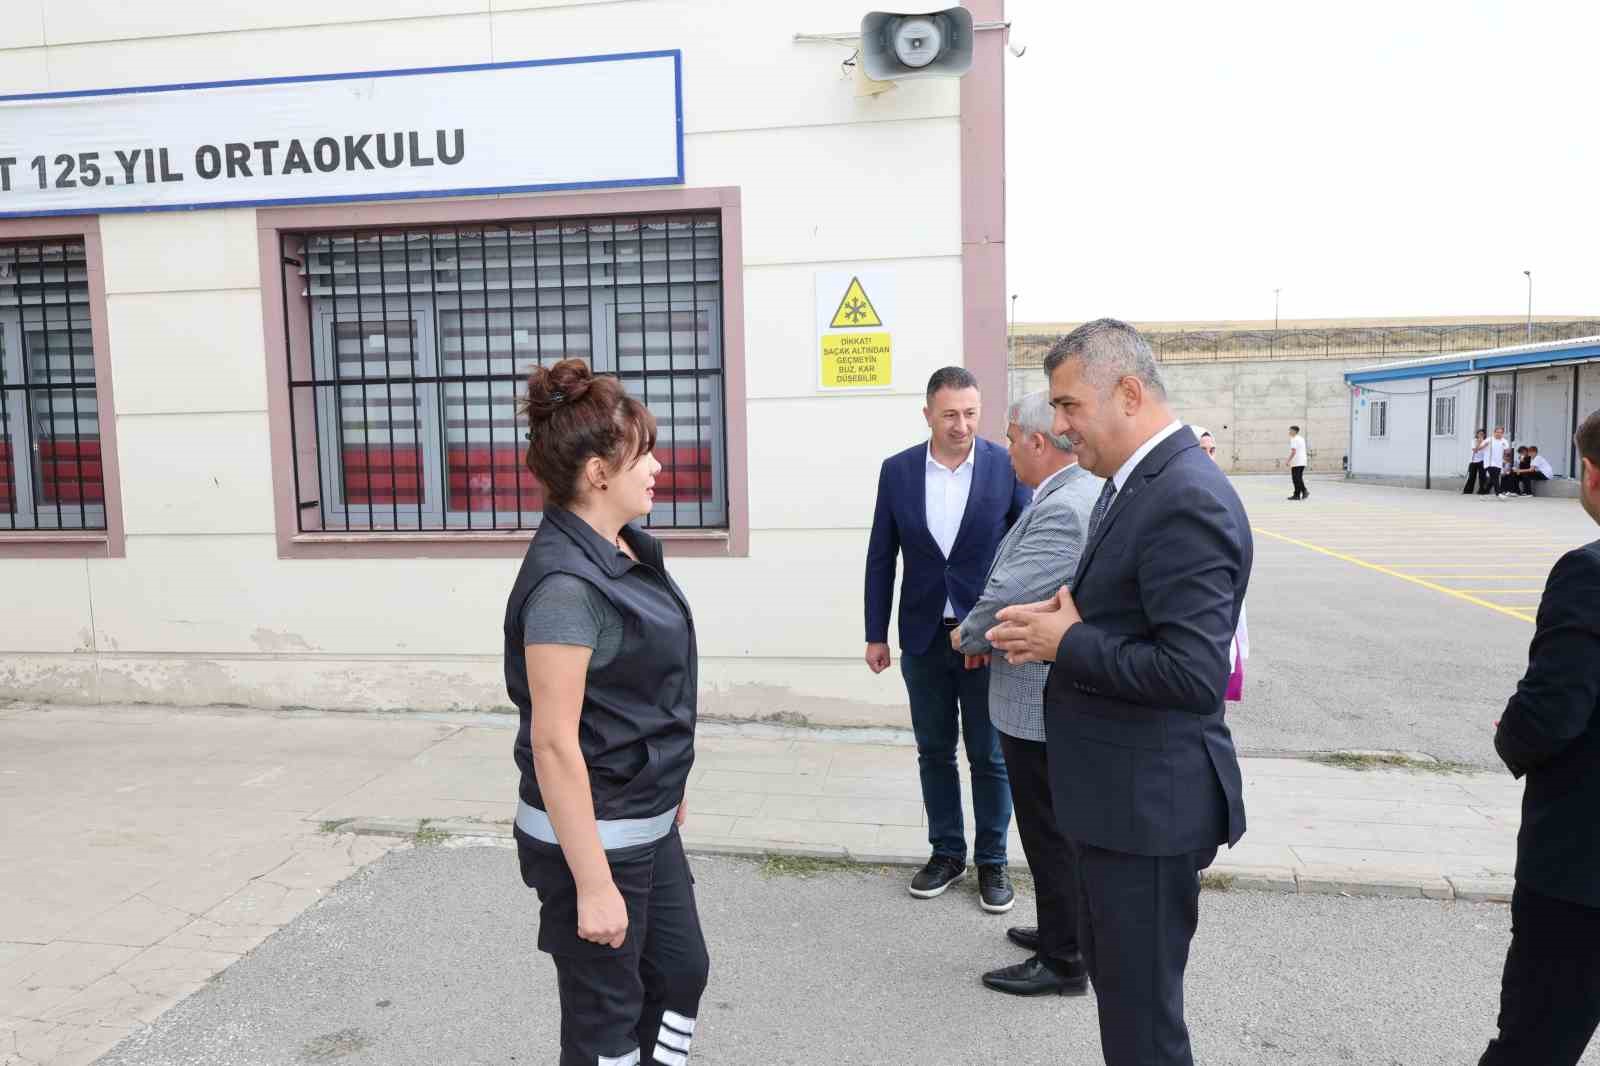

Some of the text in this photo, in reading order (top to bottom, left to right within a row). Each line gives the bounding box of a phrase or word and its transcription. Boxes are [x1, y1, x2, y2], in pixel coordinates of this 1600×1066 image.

[31, 147, 184, 190] 125.YIL
[195, 129, 465, 180] ORTAOKULU
[852, 346, 890, 354] ALTINDAN
[858, 365, 875, 373] KAR
